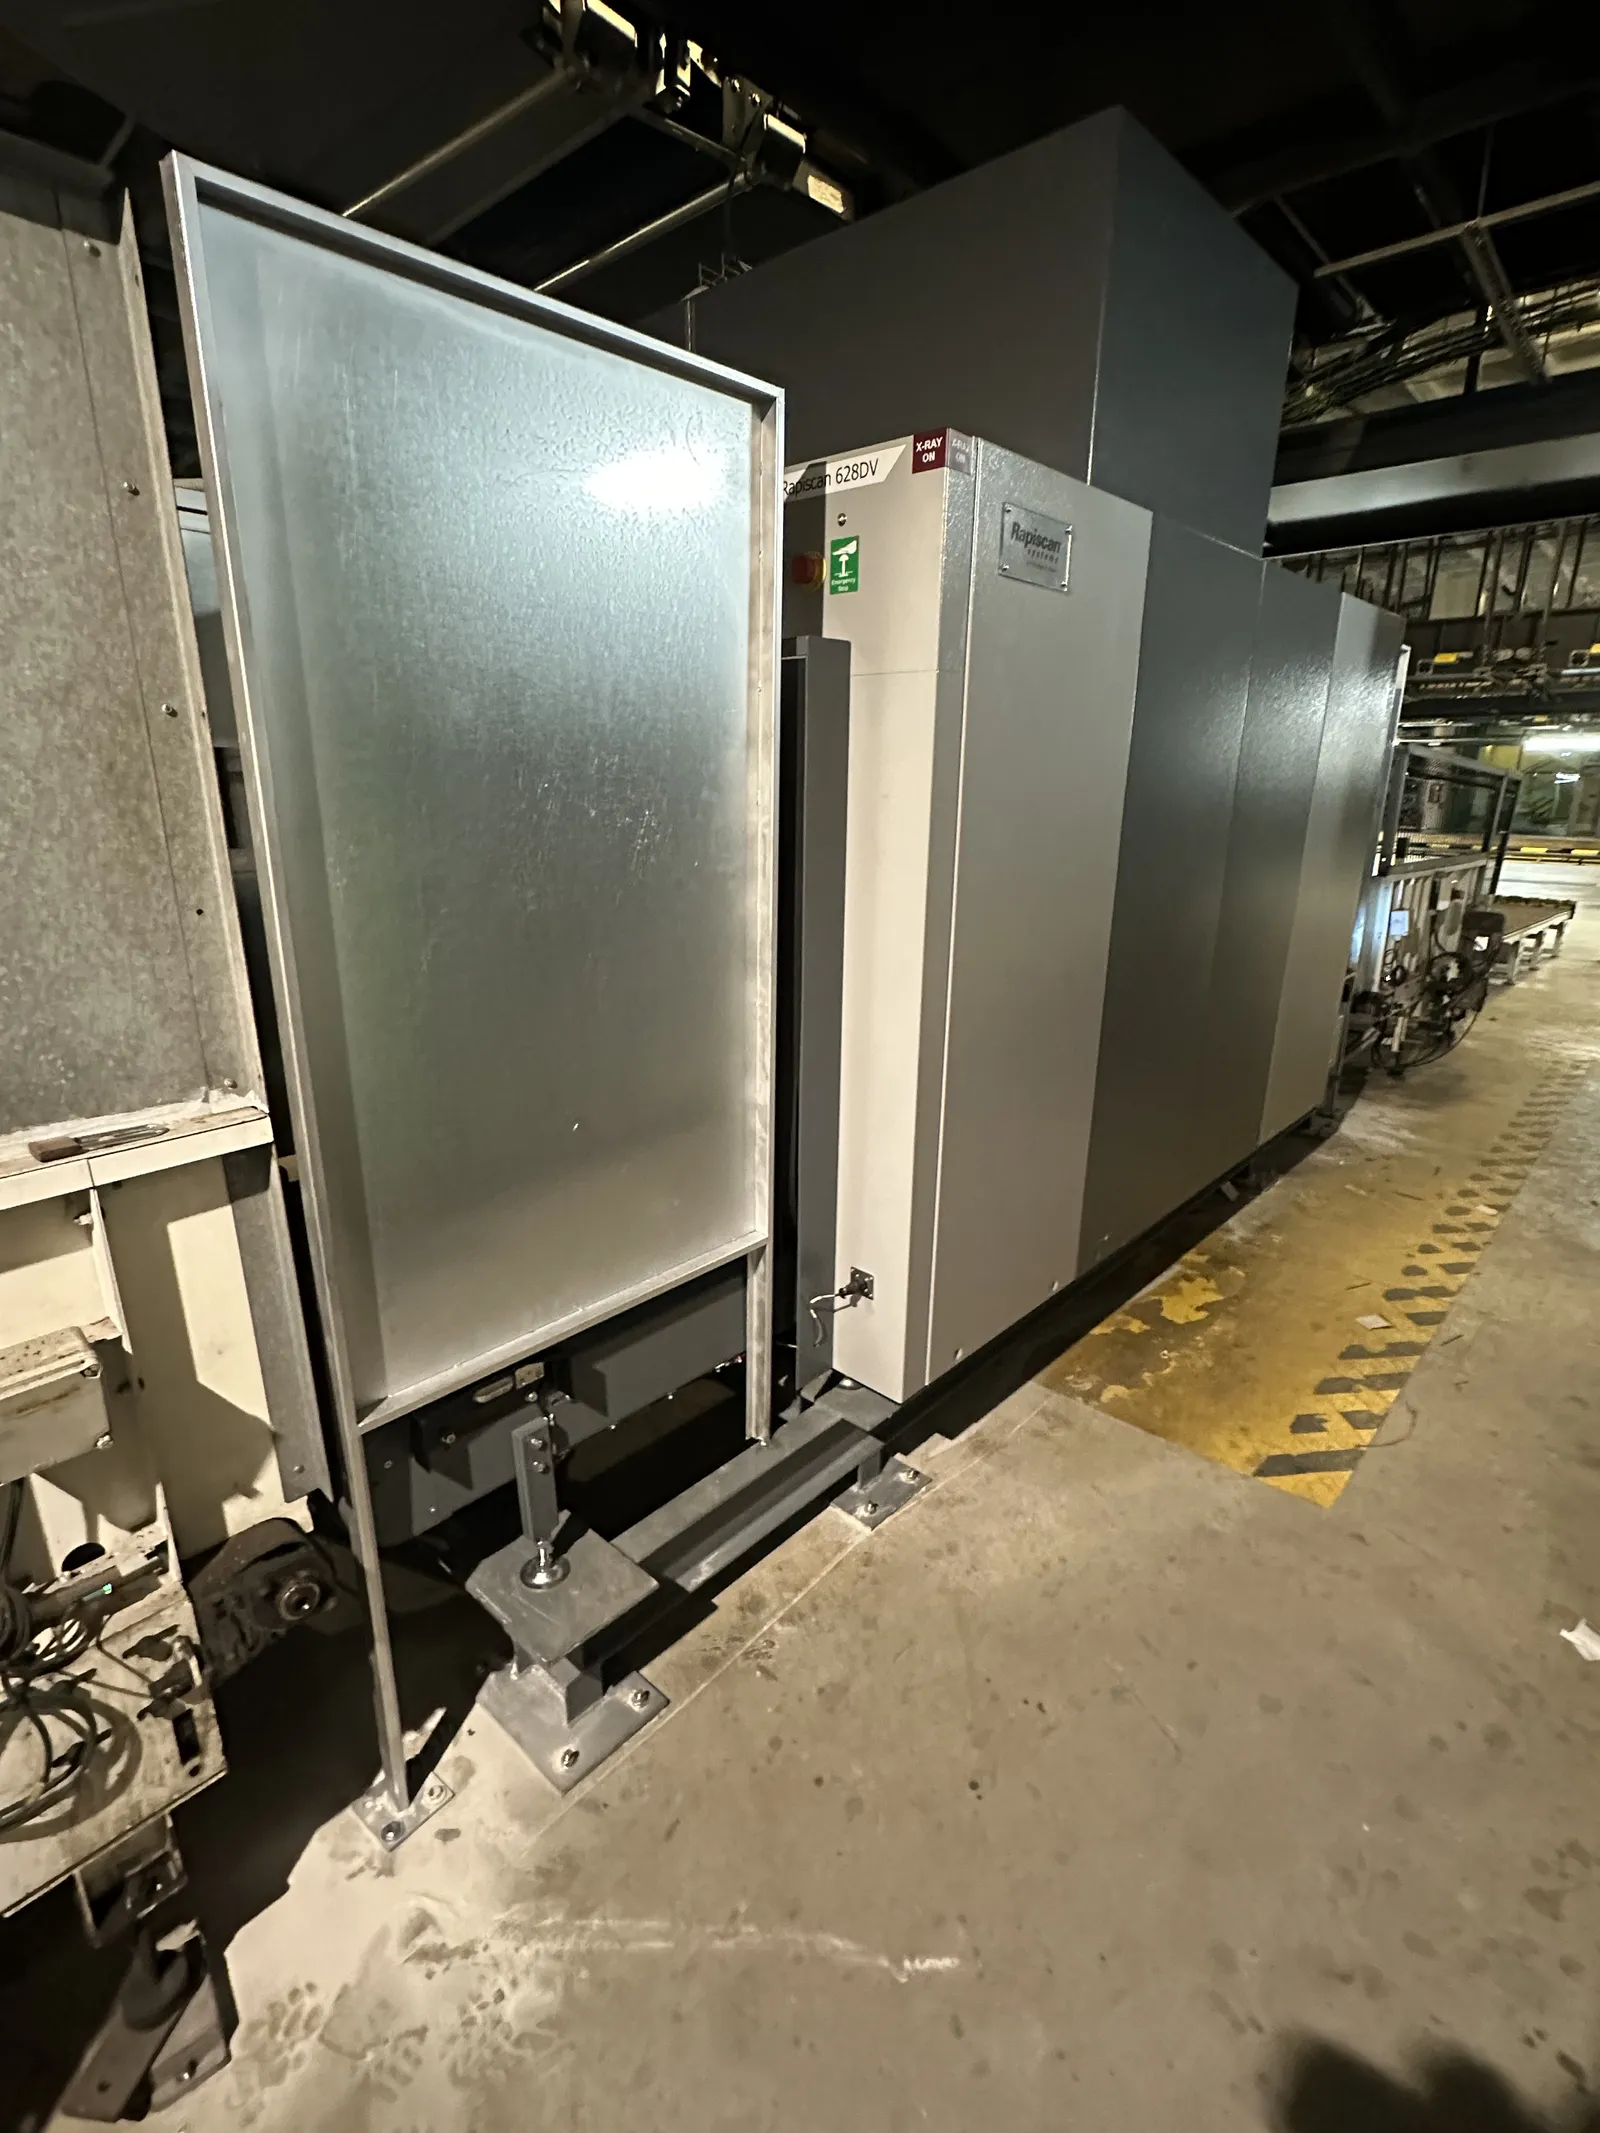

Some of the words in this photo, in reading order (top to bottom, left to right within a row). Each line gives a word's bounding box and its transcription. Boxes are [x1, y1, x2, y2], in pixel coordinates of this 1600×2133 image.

[915, 436, 943, 453] X-RAY
[922, 451, 936, 463] ON
[835, 457, 879, 484] 628DV
[1011, 521, 1062, 554] Rapiscan
